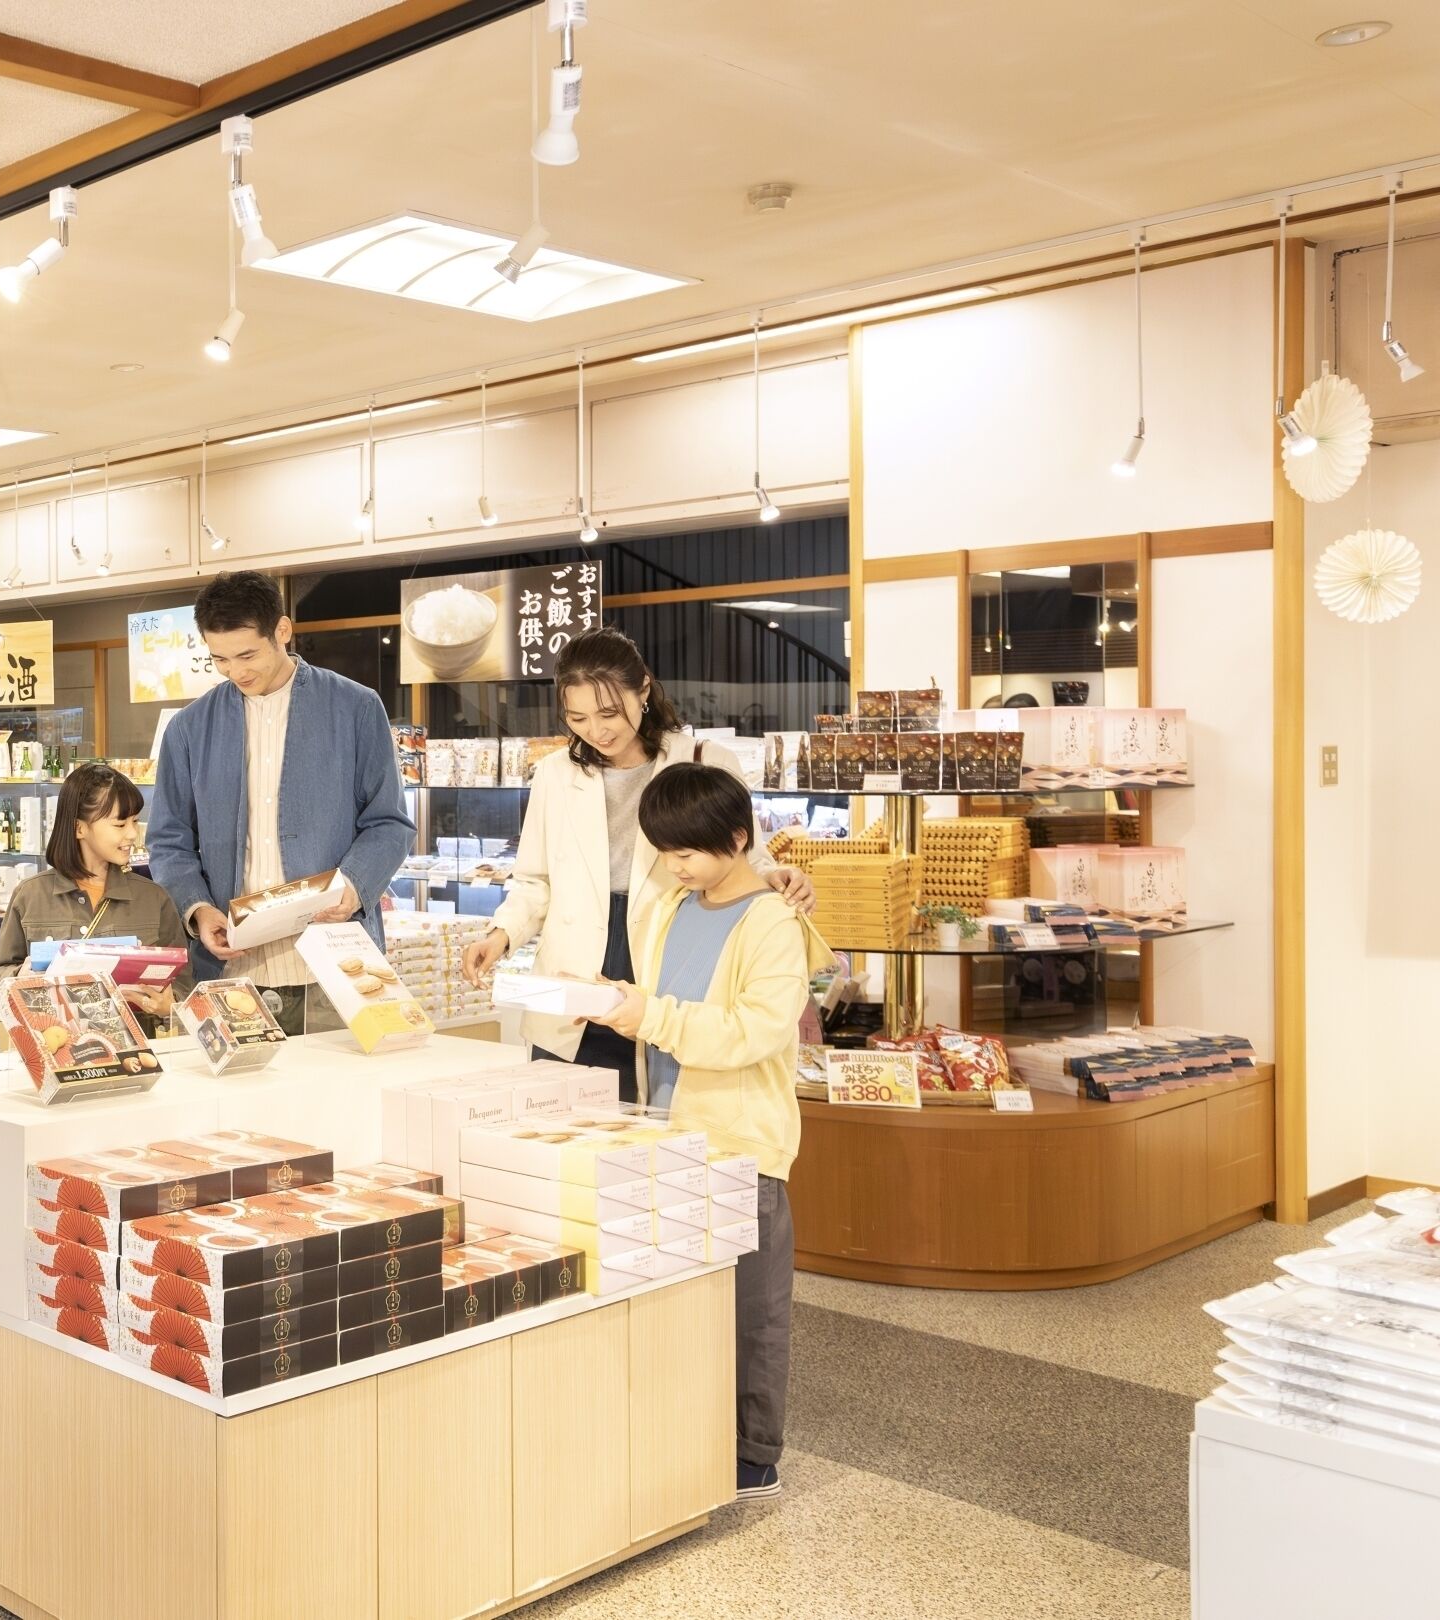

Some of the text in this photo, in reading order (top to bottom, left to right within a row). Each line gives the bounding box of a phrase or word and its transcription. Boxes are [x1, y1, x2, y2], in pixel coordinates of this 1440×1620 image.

[547, 565, 574, 655] ご飯の
[130, 616, 159, 635] 冷えた
[518, 590, 543, 676] お供に
[840, 1064, 884, 1075] かぼちゃ
[845, 1074, 880, 1084] みるく
